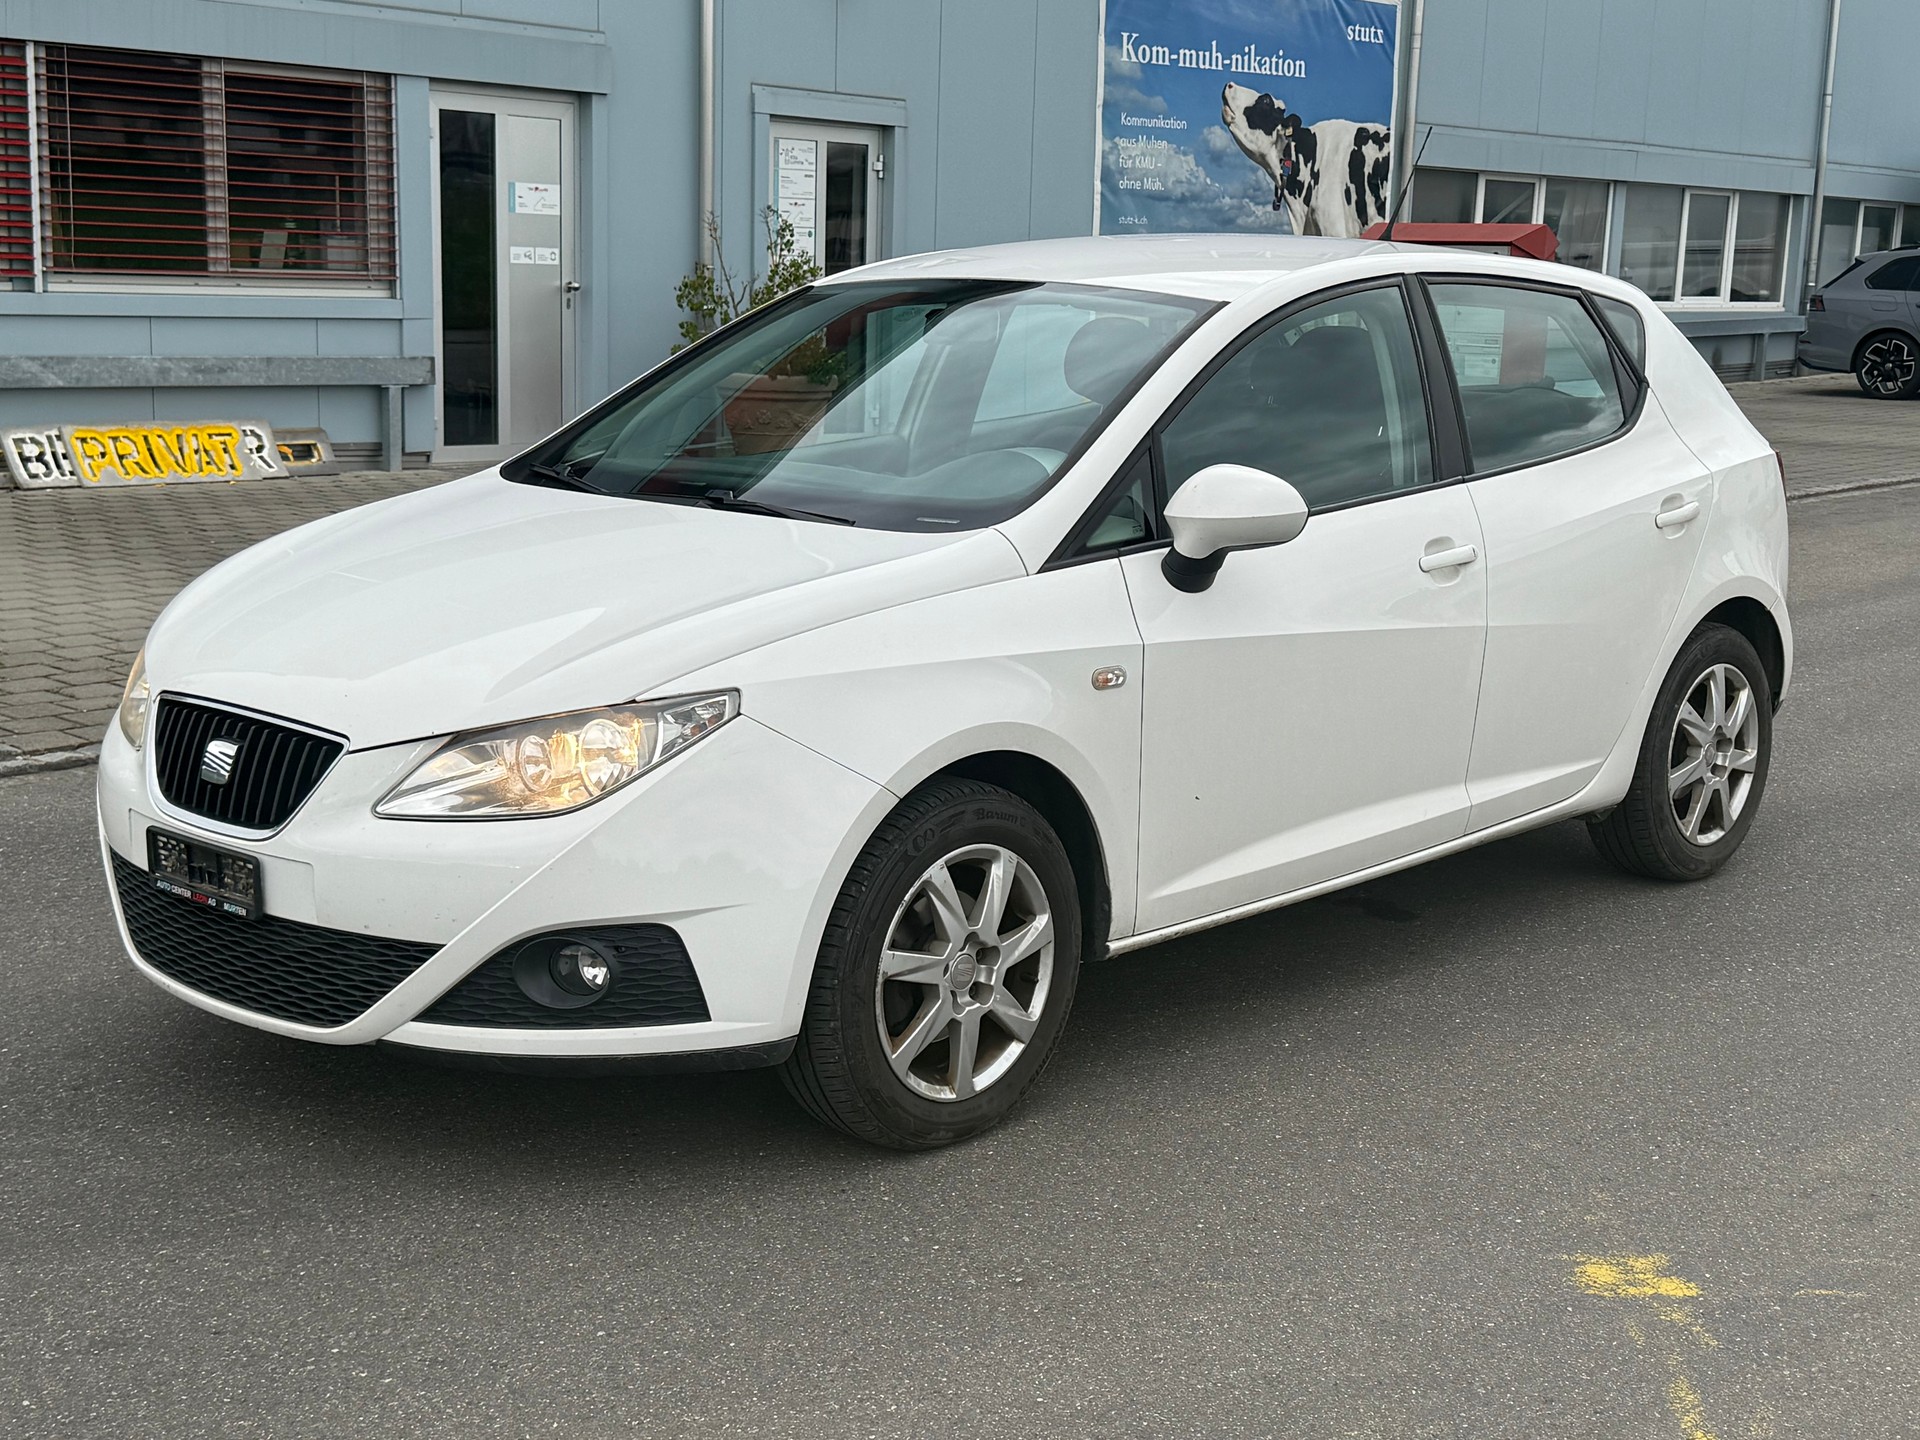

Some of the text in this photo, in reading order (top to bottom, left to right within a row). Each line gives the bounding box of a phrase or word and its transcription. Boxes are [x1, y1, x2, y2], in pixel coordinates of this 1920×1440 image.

[1120, 31, 1306, 78] Kom-muh-nikation
[1120, 112, 1187, 130] Kommunikation
[1120, 135, 1168, 149] aus Muhen
[1119, 154, 1133, 168] für
[1135, 155, 1155, 169] KMU
[1119, 176, 1165, 191] ohne Müh.
[71, 426, 242, 482] PRIVAT
[157, 880, 171, 891] AUTO
[171, 885, 191, 899] CENTER
[208, 898, 216, 907] AG
[224, 903, 246, 916] MURTEN
